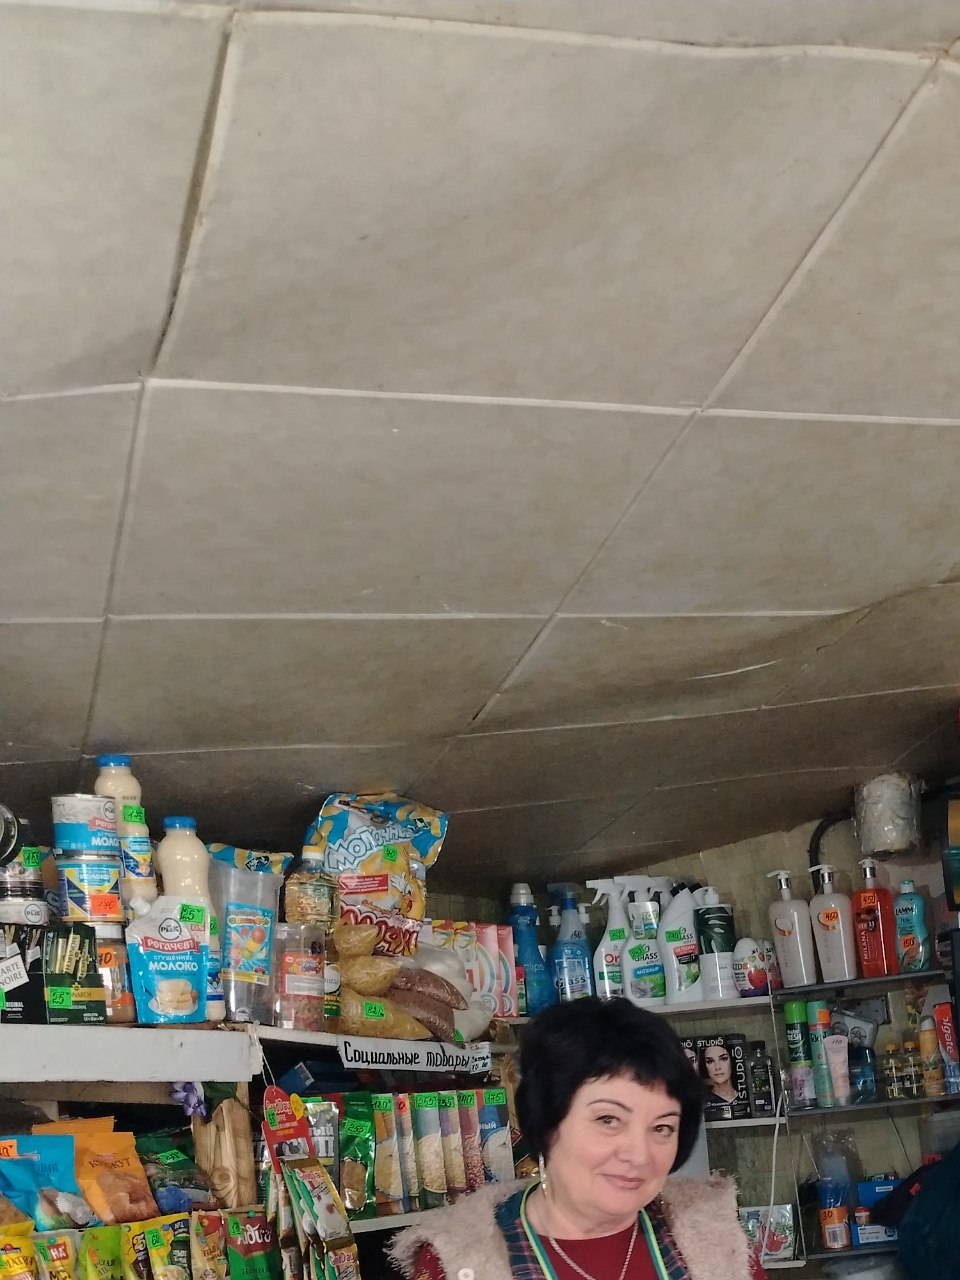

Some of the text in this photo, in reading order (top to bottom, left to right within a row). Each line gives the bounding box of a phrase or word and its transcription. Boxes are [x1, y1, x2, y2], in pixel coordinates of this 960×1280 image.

[0, 961, 23, 975] ARTE
[149, 961, 199, 972] МОЛОКО
[344, 1040, 420, 1068] Социальные
[425, 1044, 470, 1068] товары
